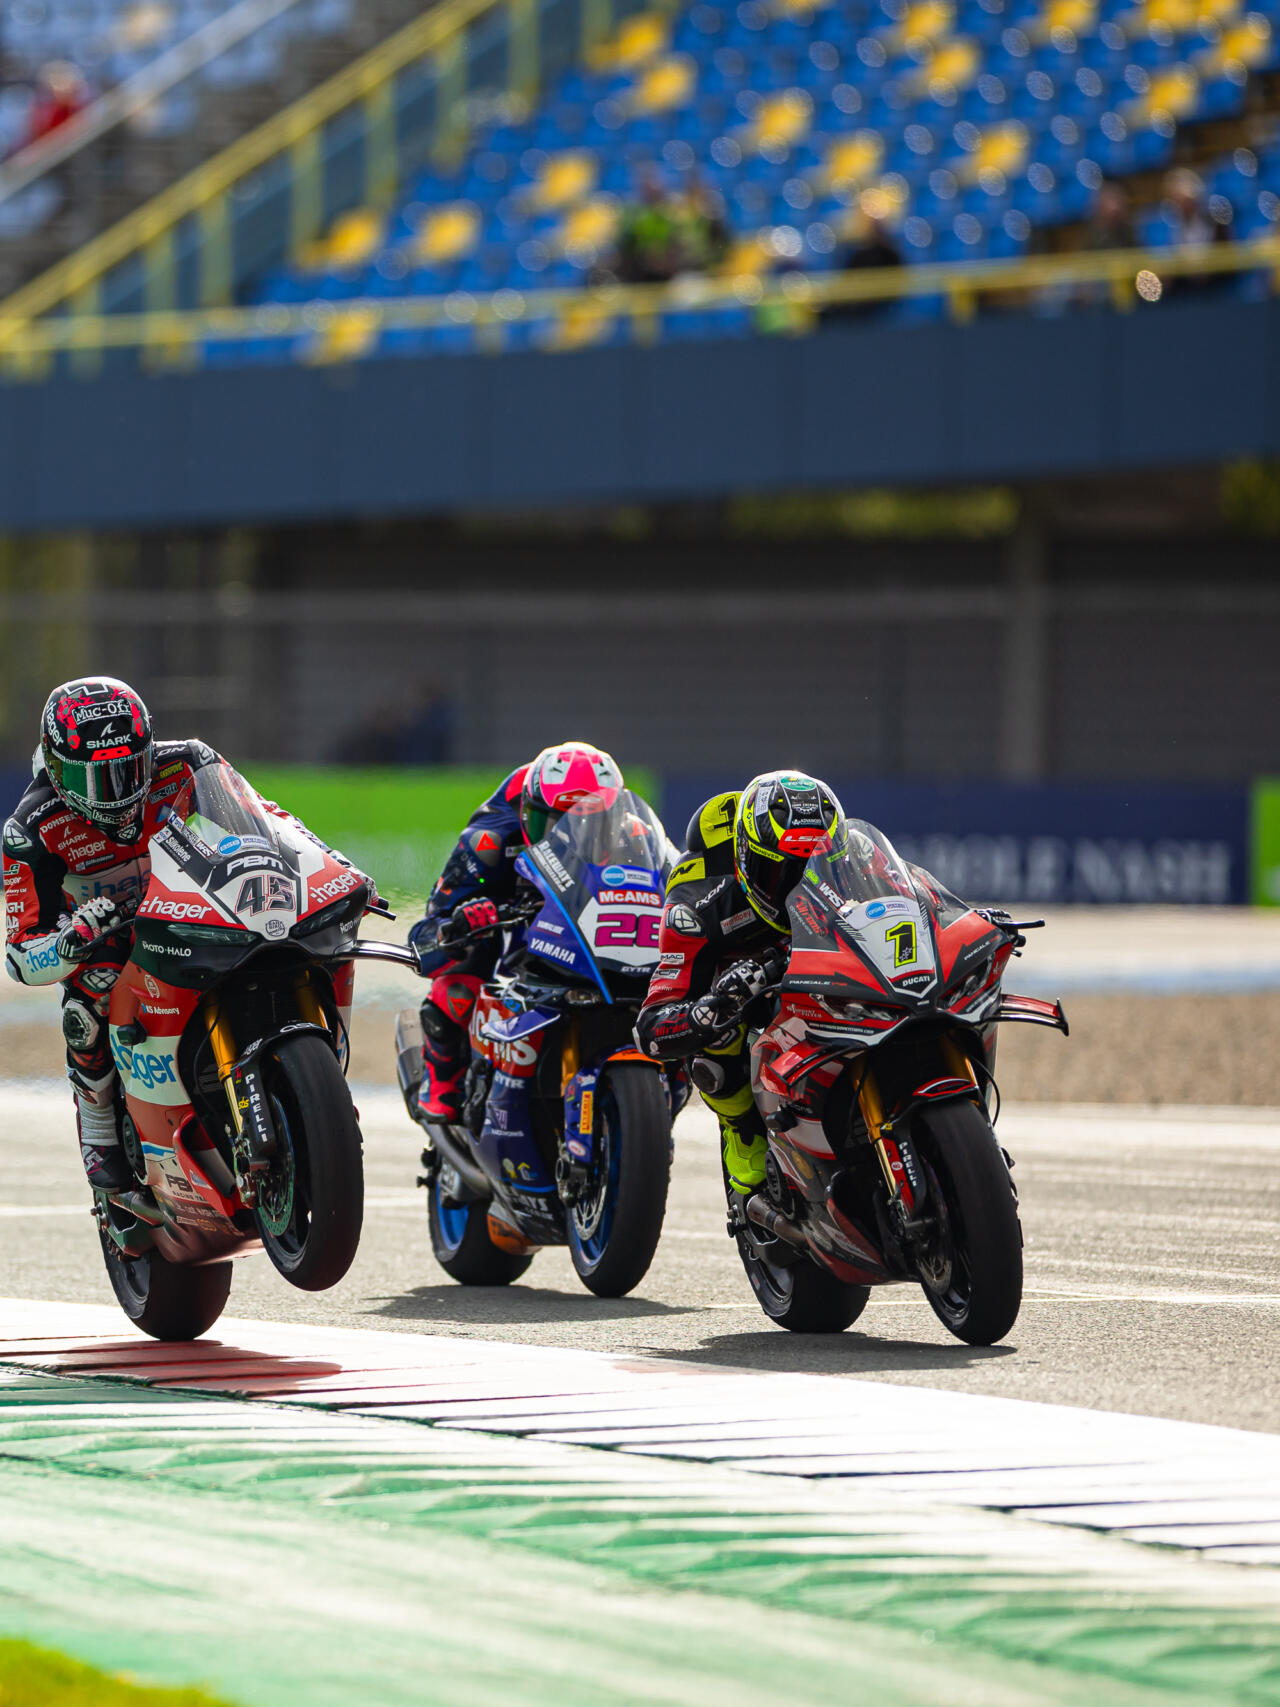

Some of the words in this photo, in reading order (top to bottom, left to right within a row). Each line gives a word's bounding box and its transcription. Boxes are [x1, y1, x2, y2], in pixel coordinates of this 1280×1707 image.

[76, 701, 130, 721] Muc-Off
[86, 734, 131, 749] SHARK
[58, 832, 87, 850] SHARK
[67, 840, 106, 862] :hager
[227, 855, 283, 877] PBM
[235, 874, 297, 917] 45
[310, 870, 359, 904] :hager
[599, 891, 660, 905] McAMS
[819, 882, 844, 908] WRS
[140, 896, 212, 919] :hager
[530, 938, 576, 964] YAMAHA
[885, 921, 917, 968] 1
[902, 975, 930, 987] DUCATI
[245, 1073, 268, 1142] PIRELLI
